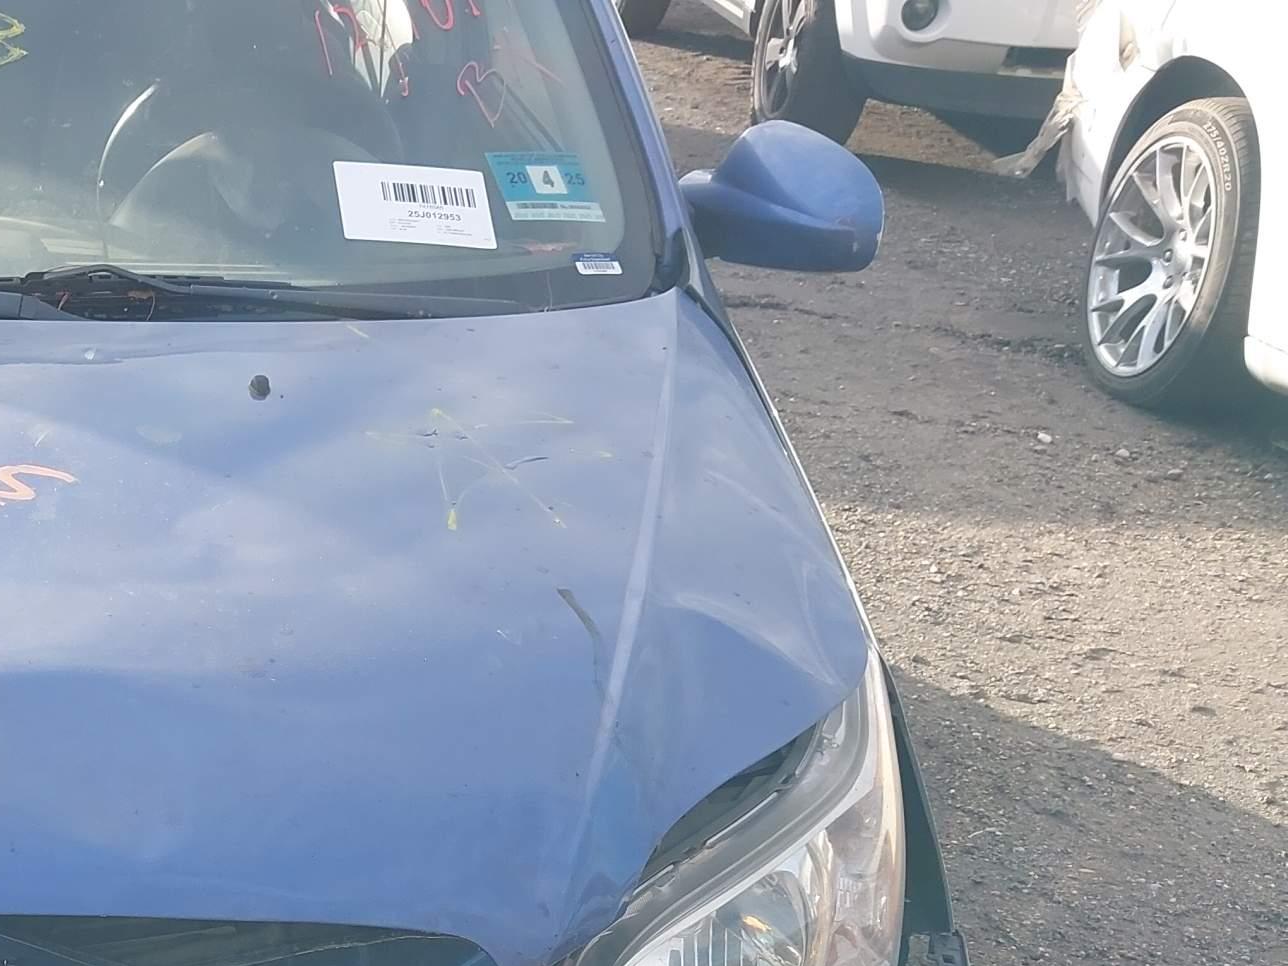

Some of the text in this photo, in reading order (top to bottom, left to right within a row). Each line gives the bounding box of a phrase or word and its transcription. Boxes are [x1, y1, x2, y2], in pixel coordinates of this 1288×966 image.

[506, 171, 528, 185] 20
[542, 169, 555, 188] 4
[407, 209, 462, 222] 25J012953
